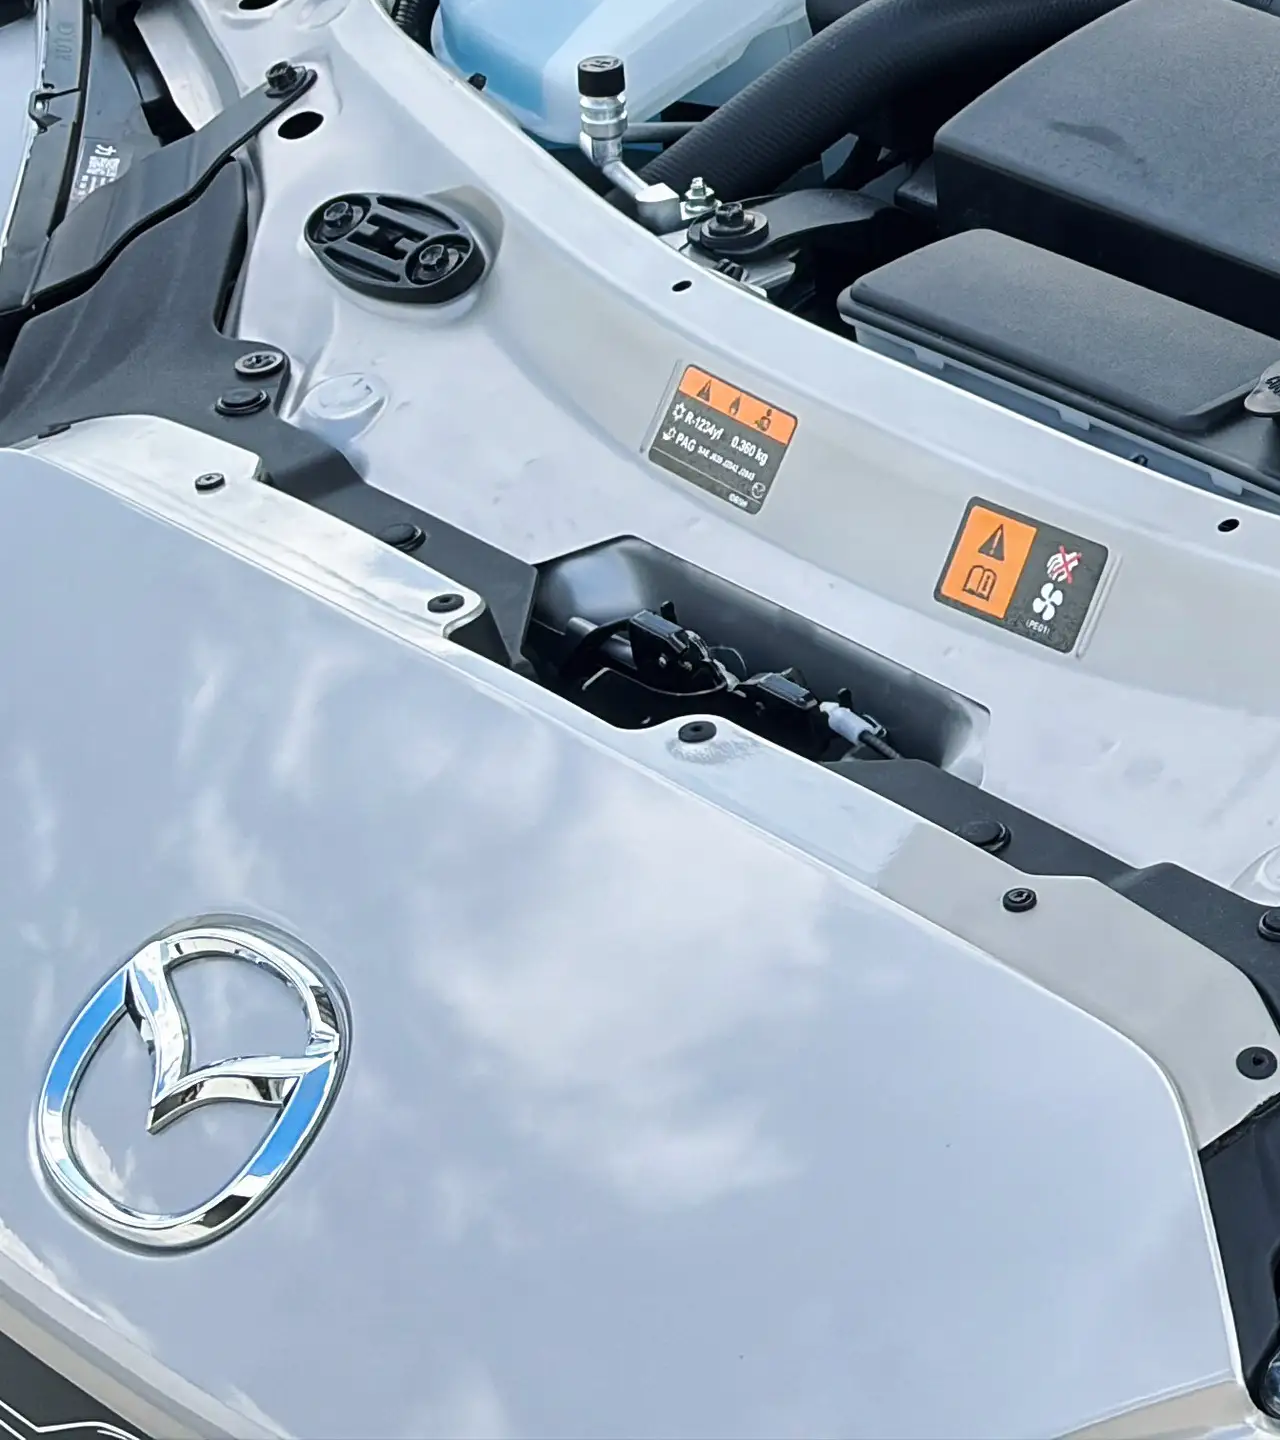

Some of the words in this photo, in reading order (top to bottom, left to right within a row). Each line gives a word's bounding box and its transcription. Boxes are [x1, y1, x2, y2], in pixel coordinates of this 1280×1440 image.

[675, 432, 697, 452] PAG
[684, 411, 724, 440] R-1234yf
[754, 448, 769, 467] kg
